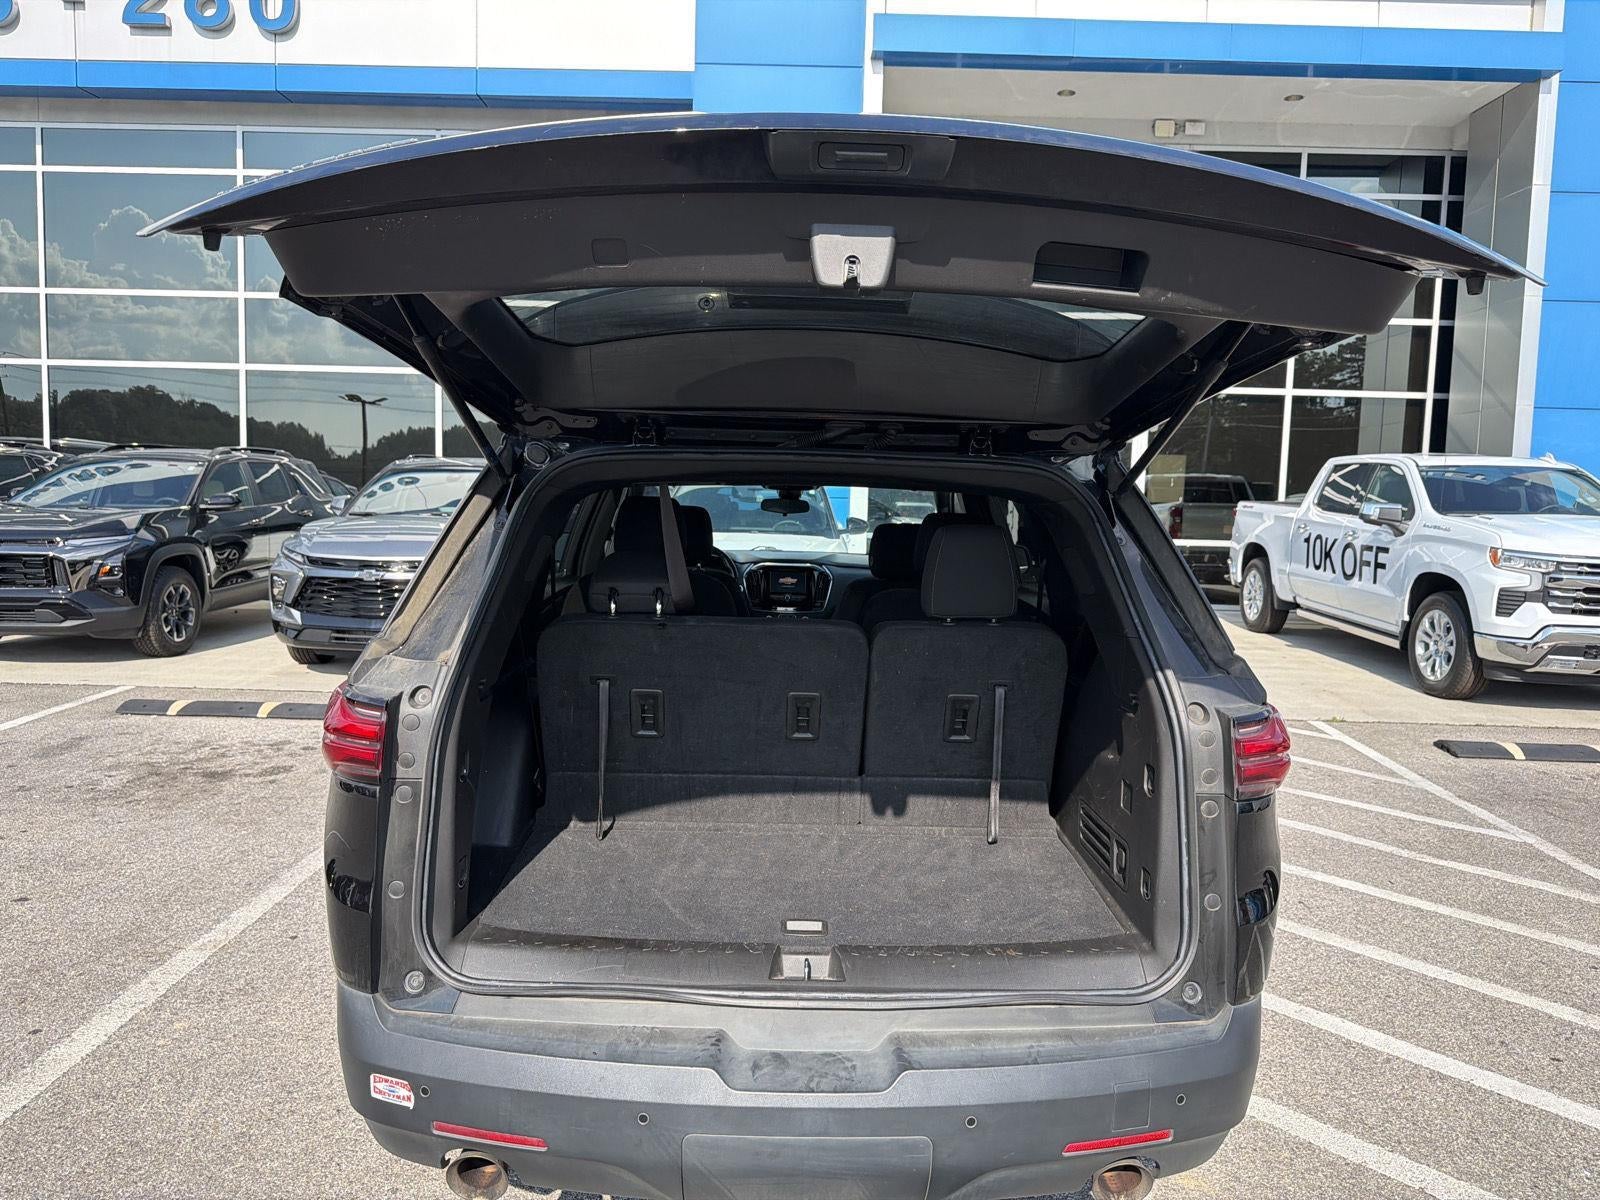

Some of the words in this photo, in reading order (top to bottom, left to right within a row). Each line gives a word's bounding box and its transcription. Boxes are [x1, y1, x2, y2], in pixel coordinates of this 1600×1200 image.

[1304, 532, 1338, 574] 10K
[1341, 542, 1390, 585] OFF
[373, 1075, 412, 1093] EDWARDS
